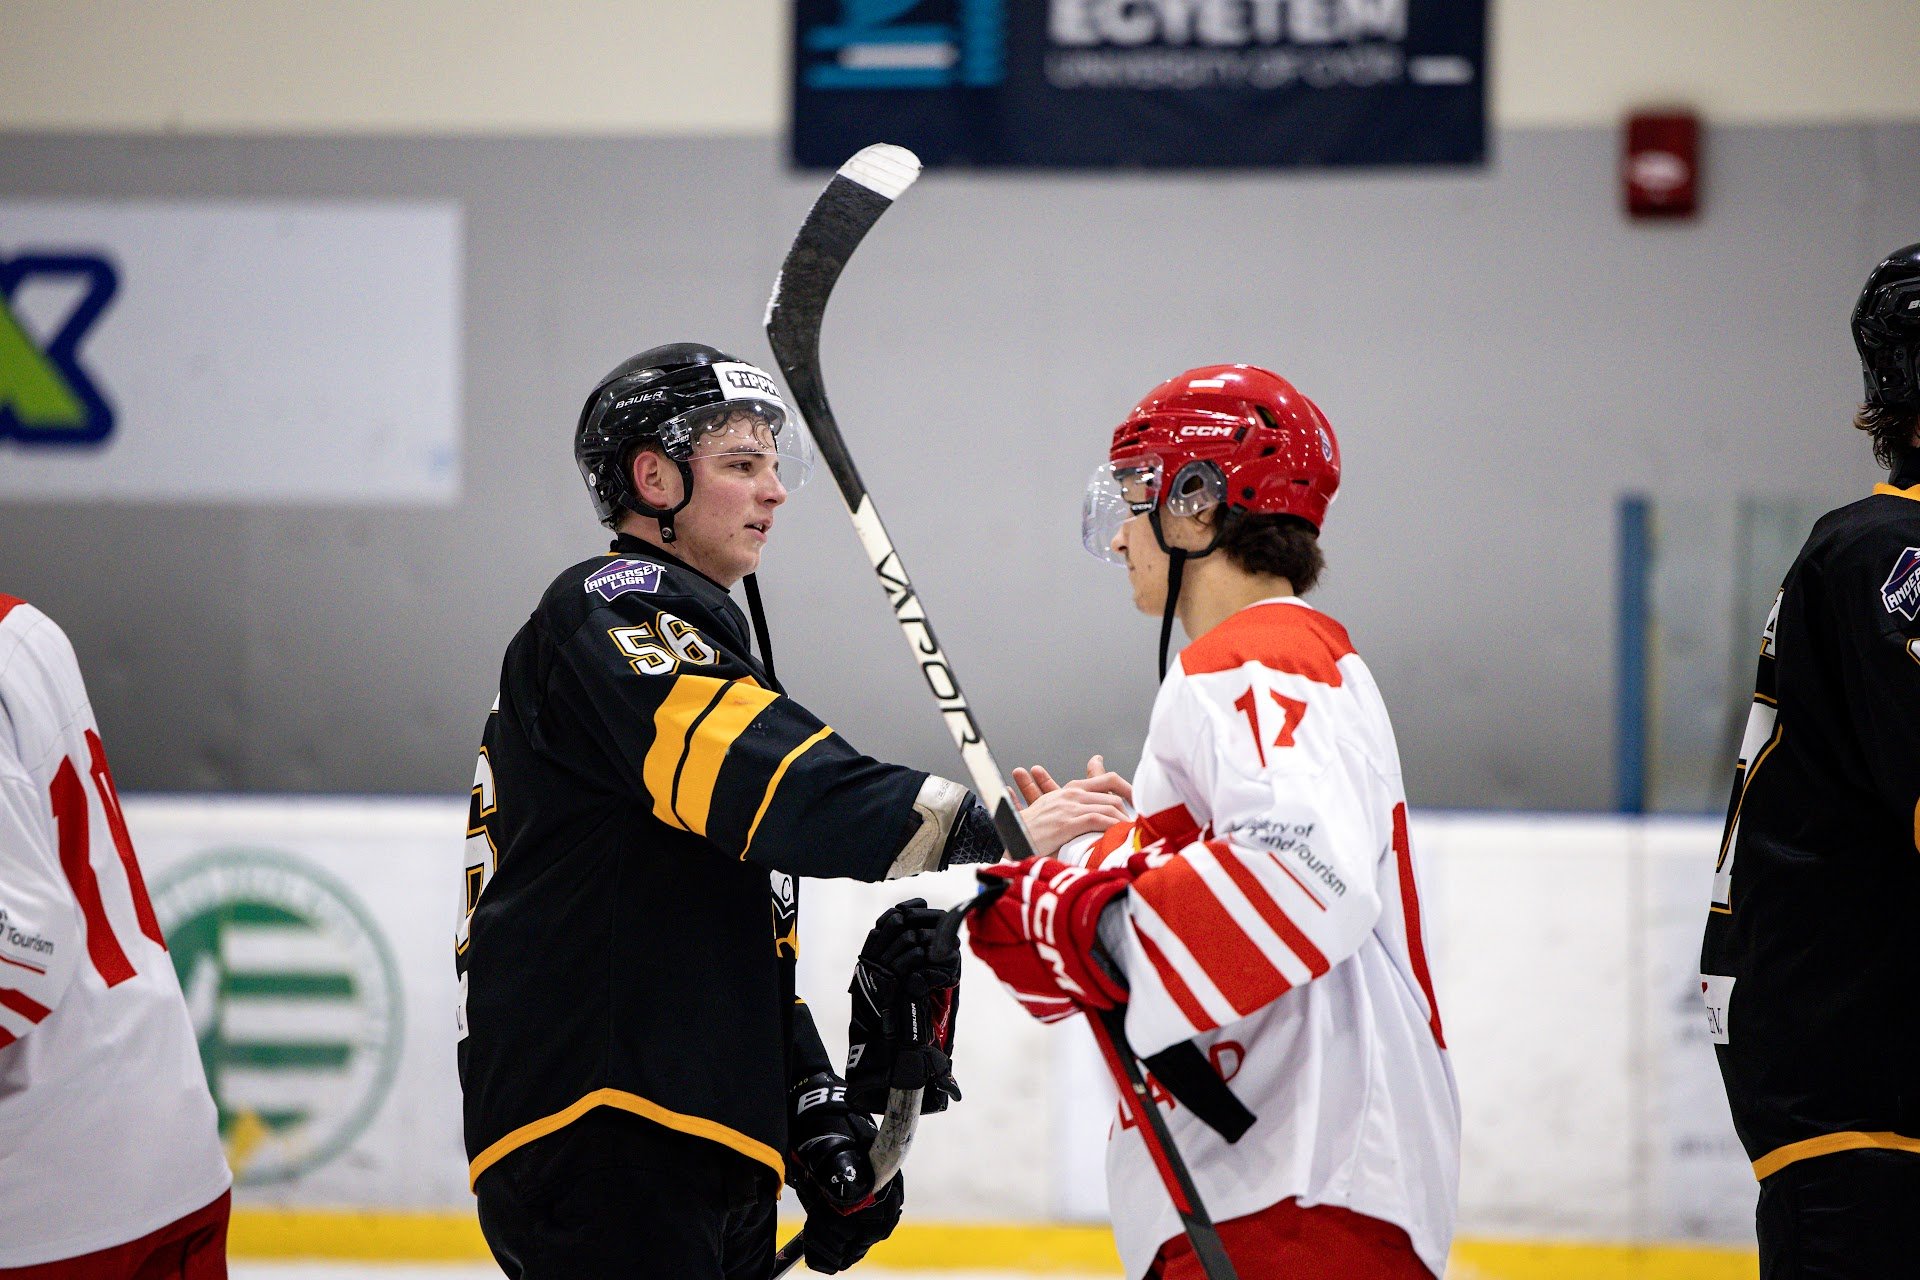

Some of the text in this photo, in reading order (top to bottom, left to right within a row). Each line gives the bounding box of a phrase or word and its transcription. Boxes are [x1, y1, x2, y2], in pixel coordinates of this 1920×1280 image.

[615, 390, 664, 410] BAUER
[1180, 425, 1233, 437] CCM
[610, 576, 645, 590] LIGA
[607, 611, 720, 675] 56
[1234, 684, 1308, 768] 17
[7, 926, 55, 957] Tourism
